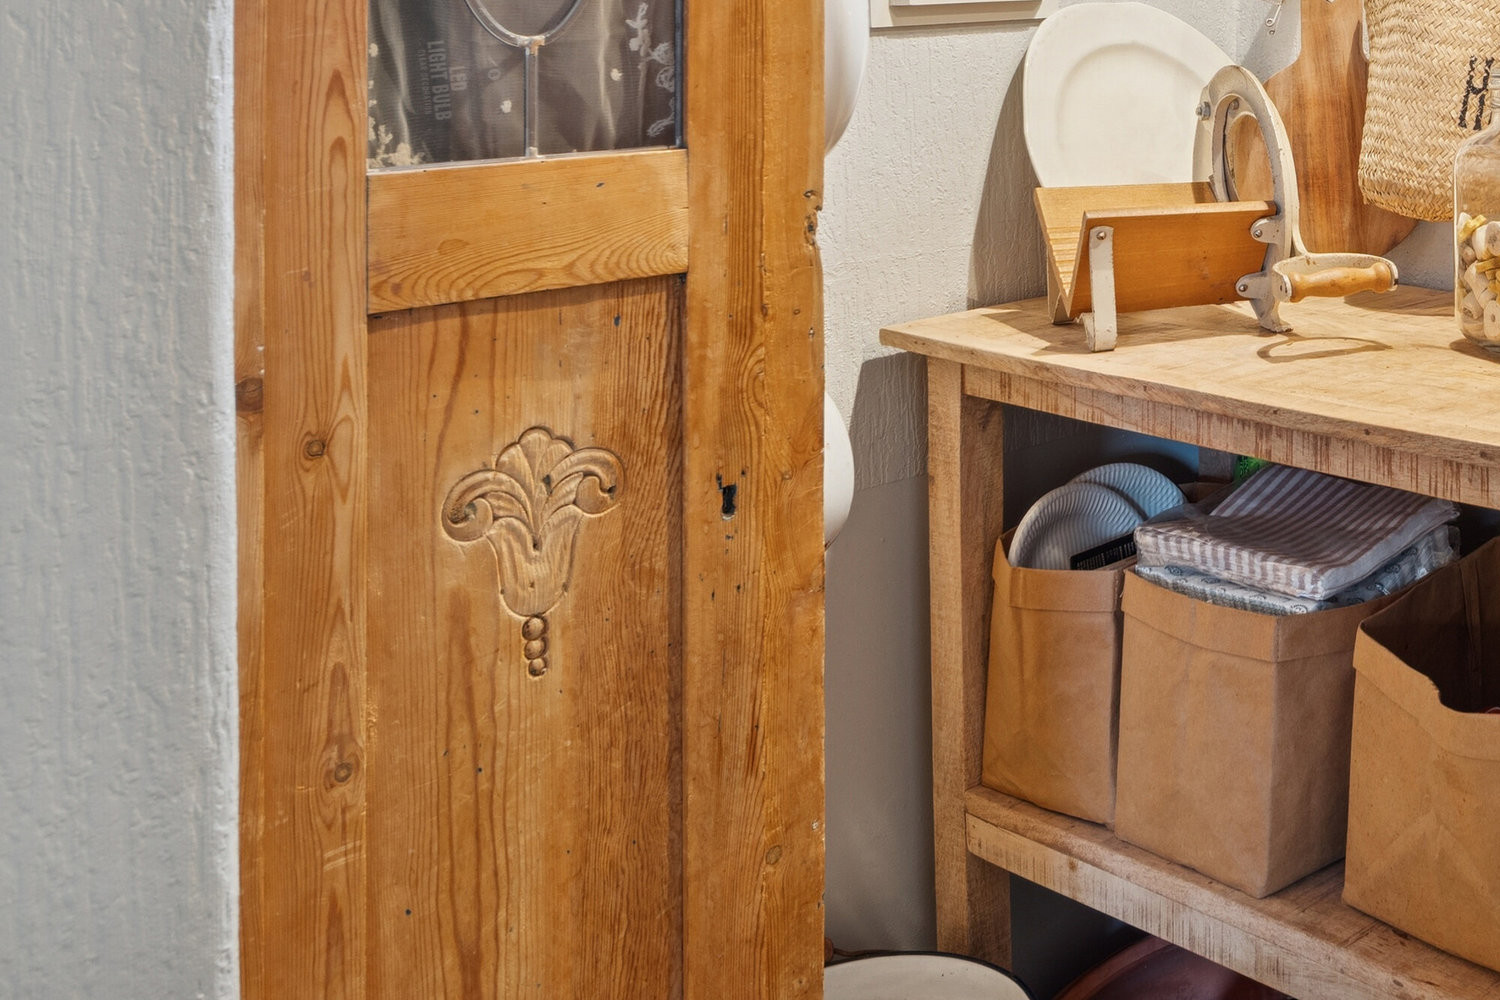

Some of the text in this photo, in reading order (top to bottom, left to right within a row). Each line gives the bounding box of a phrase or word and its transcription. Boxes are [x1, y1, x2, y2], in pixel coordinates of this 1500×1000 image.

[427, 40, 452, 121] LIGHT BULB
[449, 65, 467, 92] LED
